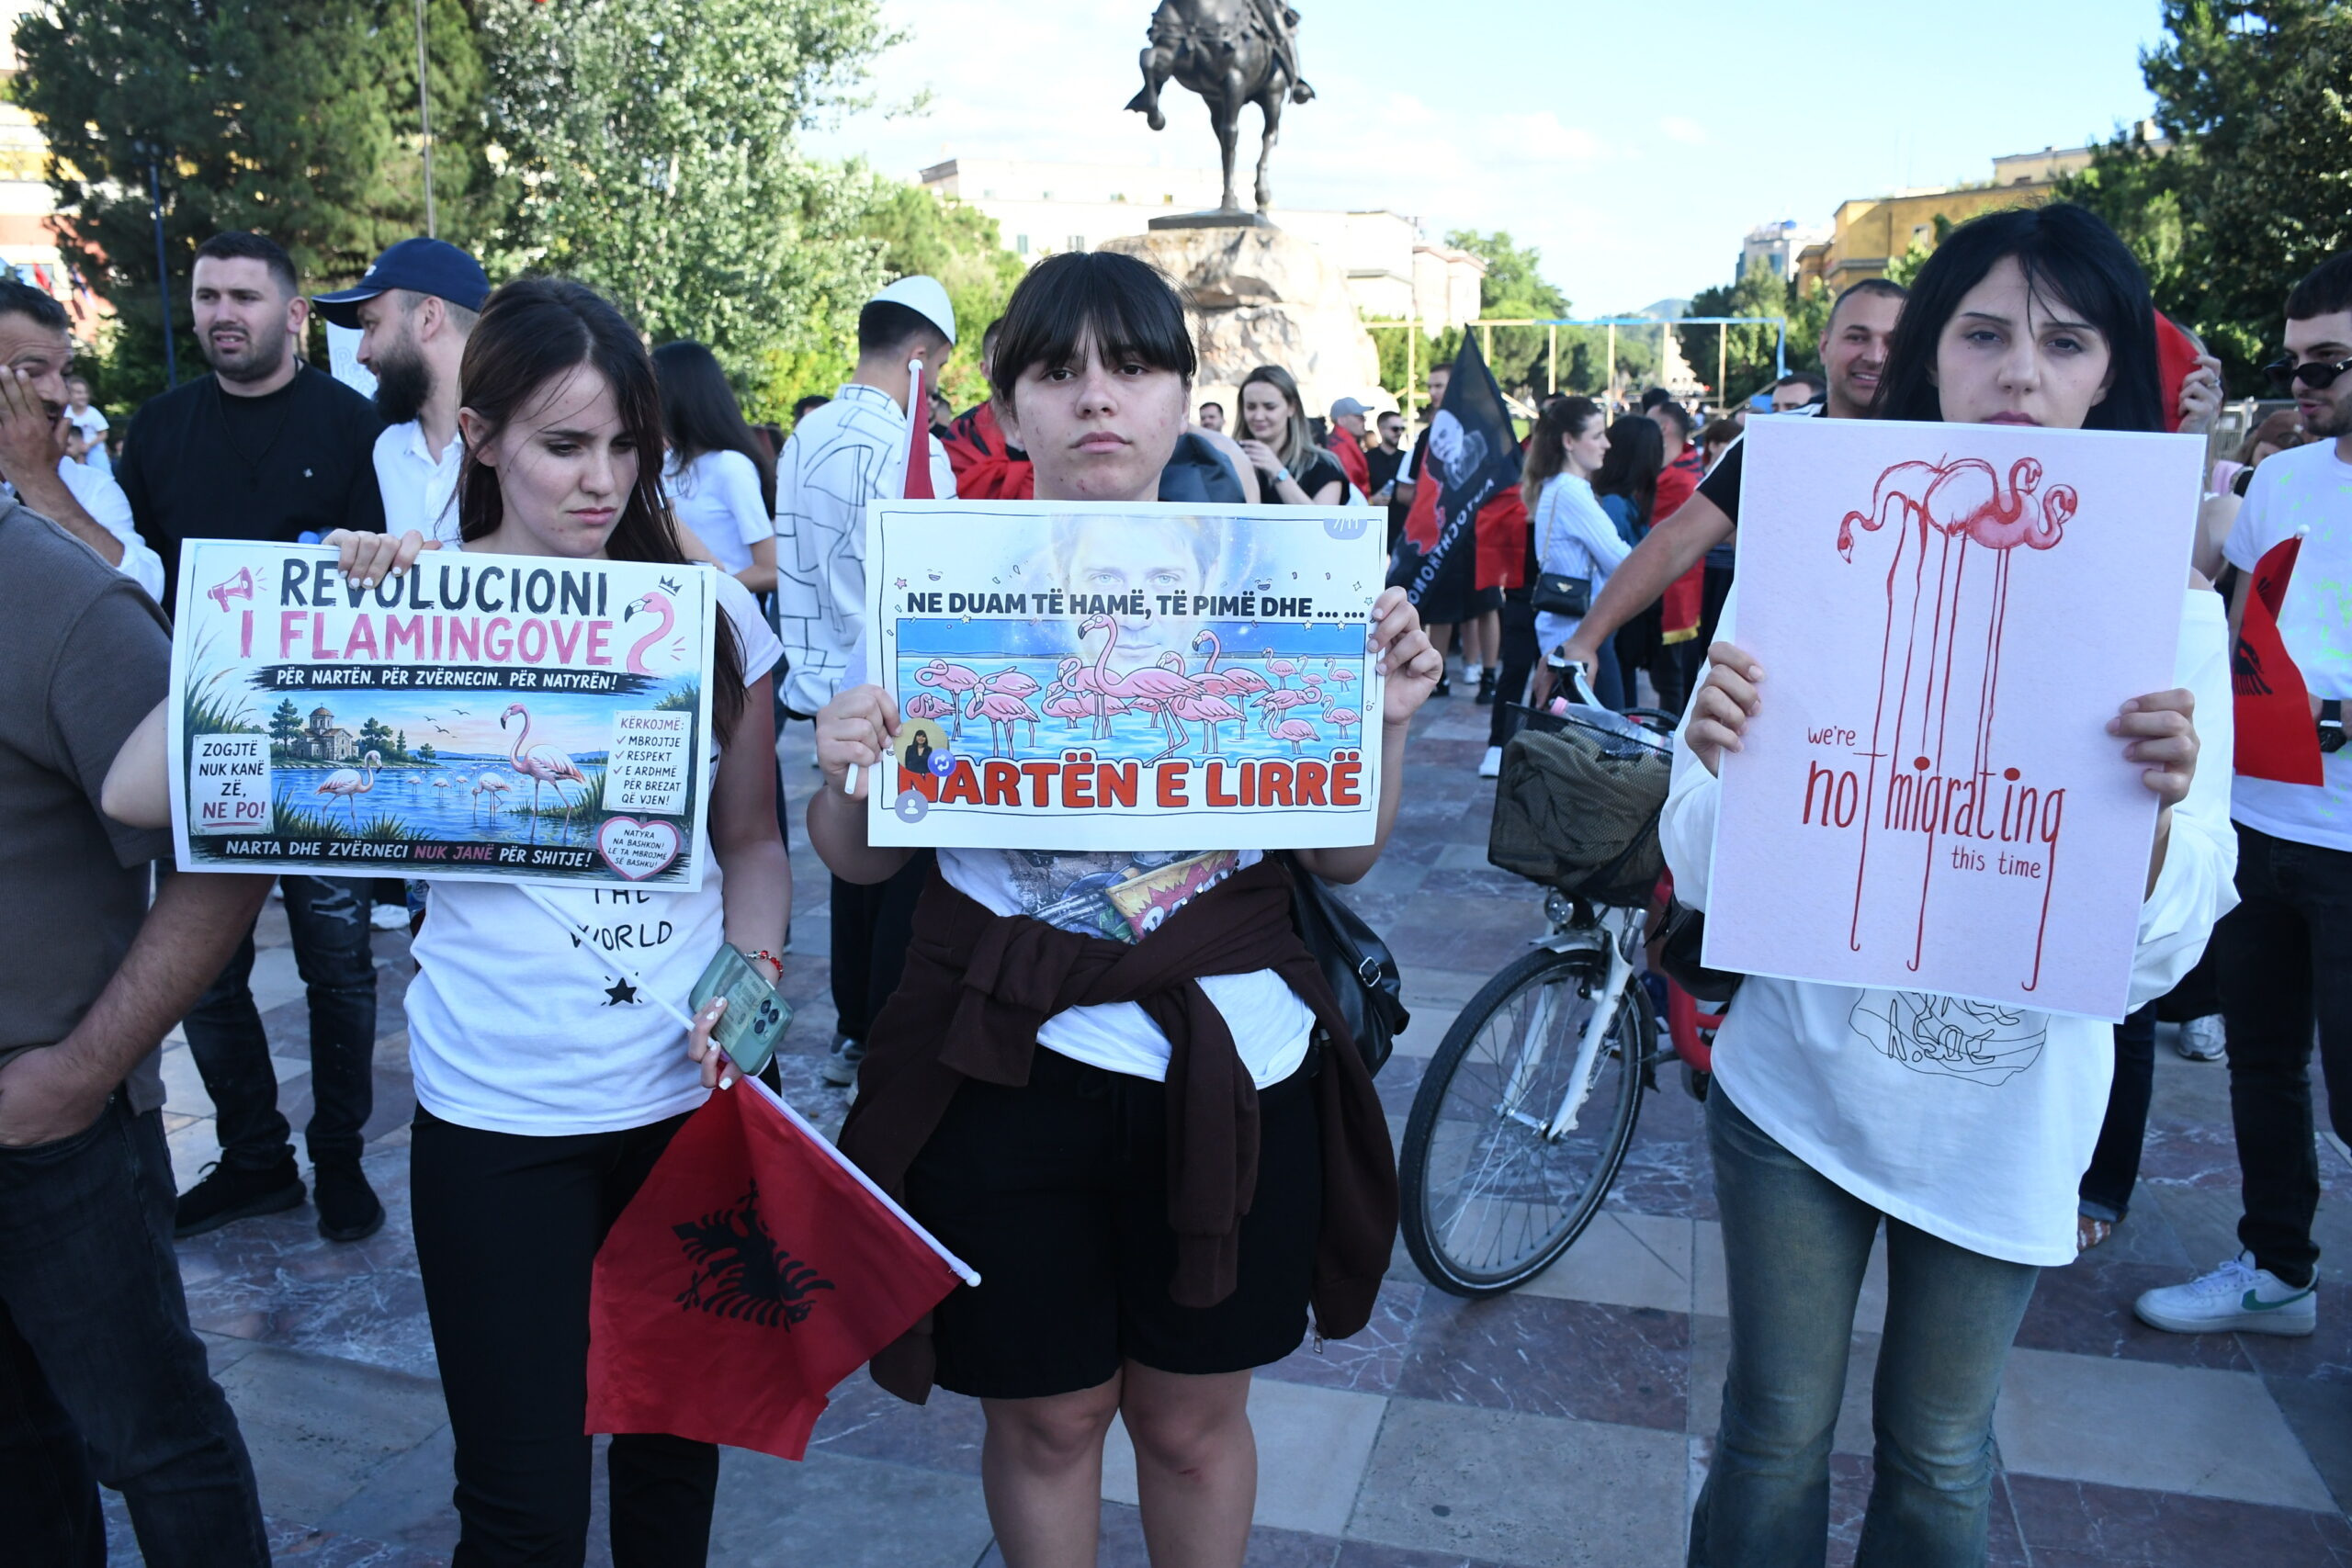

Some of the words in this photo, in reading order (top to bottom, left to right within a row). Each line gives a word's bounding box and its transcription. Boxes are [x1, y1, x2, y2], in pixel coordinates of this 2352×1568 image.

[280, 558, 607, 616] REVOLUCIONI
[907, 592, 943, 613] NE
[948, 592, 1026, 614] DUAM
[1032, 588, 1063, 615] TË
[1069, 589, 1151, 620] HAMË,
[1156, 589, 1187, 615] TË
[1193, 591, 1255, 616] PIMË
[241, 610, 254, 659] I
[279, 611, 613, 665] FLAMINGOVE
[277, 666, 304, 685] PËR
[311, 667, 375, 684] NARTËN.
[381, 667, 408, 685] PËR
[415, 668, 502, 686] ZVËRNECIN.
[509, 670, 537, 687] PËR
[542, 672, 617, 691] NATYRËN!
[620, 716, 684, 730] KËRKOJMË:
[628, 736, 681, 748] MBROJTJE
[1807, 726, 1856, 747] we're
[202, 739, 257, 757] ZOGJTË
[627, 750, 673, 761] RESPEKT
[199, 763, 227, 776] NUK
[231, 760, 265, 775] KANË
[625, 766, 631, 775] E
[634, 765, 677, 777] ARDHMË
[220, 779, 246, 797] ZË,
[624, 778, 641, 790] PËR
[645, 781, 681, 792] BREZAT
[1157, 762, 1190, 807] E
[1205, 751, 1363, 807] LIRRË
[622, 792, 636, 804] QË
[640, 795, 670, 806] VJEN!
[202, 802, 228, 818] NE
[235, 801, 266, 819] PO!
[624, 829, 655, 839] NATYRA
[225, 840, 281, 855] NARTA
[288, 841, 322, 856] DHE
[328, 840, 409, 858] ZVËRNECI
[414, 845, 447, 860] NUK
[452, 843, 494, 861] JANË
[499, 845, 526, 863] PËR
[531, 850, 593, 868] SHITJE!
[620, 848, 629, 856] TA
[627, 859, 658, 869] BASHKU!
[1951, 845, 1985, 872] this
[1998, 851, 2041, 879] time
[570, 920, 673, 951] WORLD
